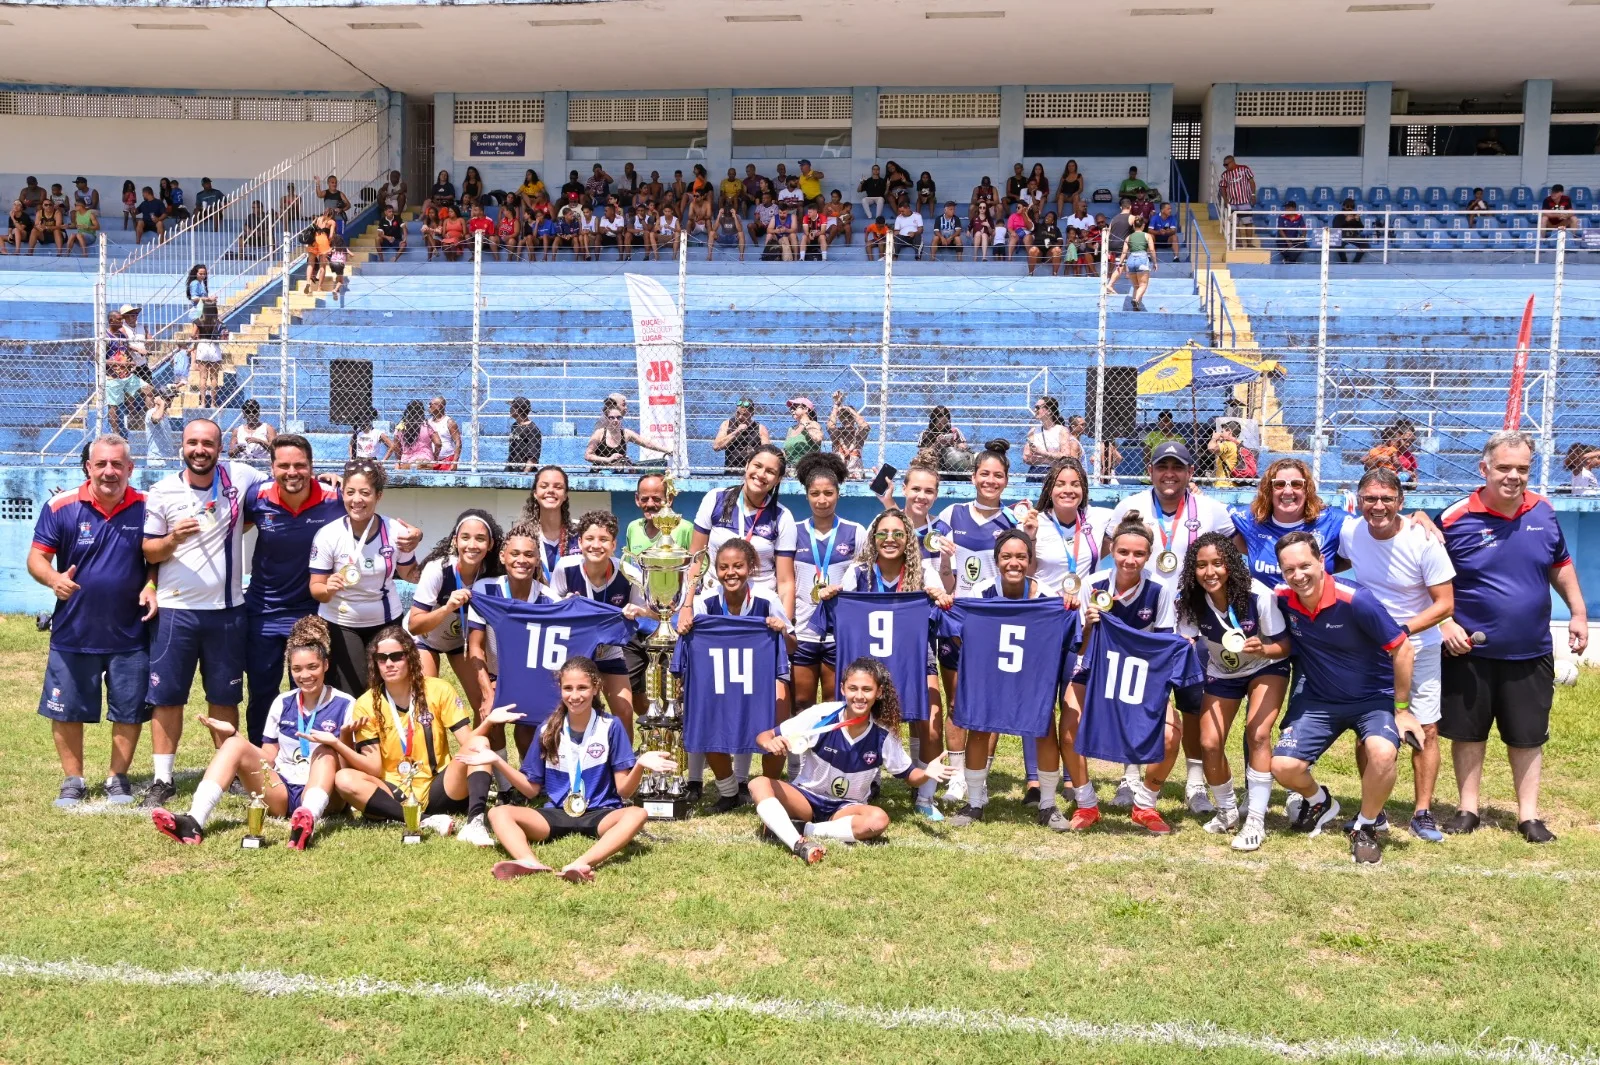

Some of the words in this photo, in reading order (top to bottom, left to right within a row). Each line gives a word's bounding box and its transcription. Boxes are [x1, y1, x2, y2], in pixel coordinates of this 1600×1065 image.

[642, 334, 663, 342] LUGAR
[526, 622, 571, 671] 16
[868, 610, 894, 658] 9
[998, 624, 1026, 673] 5
[708, 647, 754, 695] 14
[1104, 650, 1150, 705] 10
